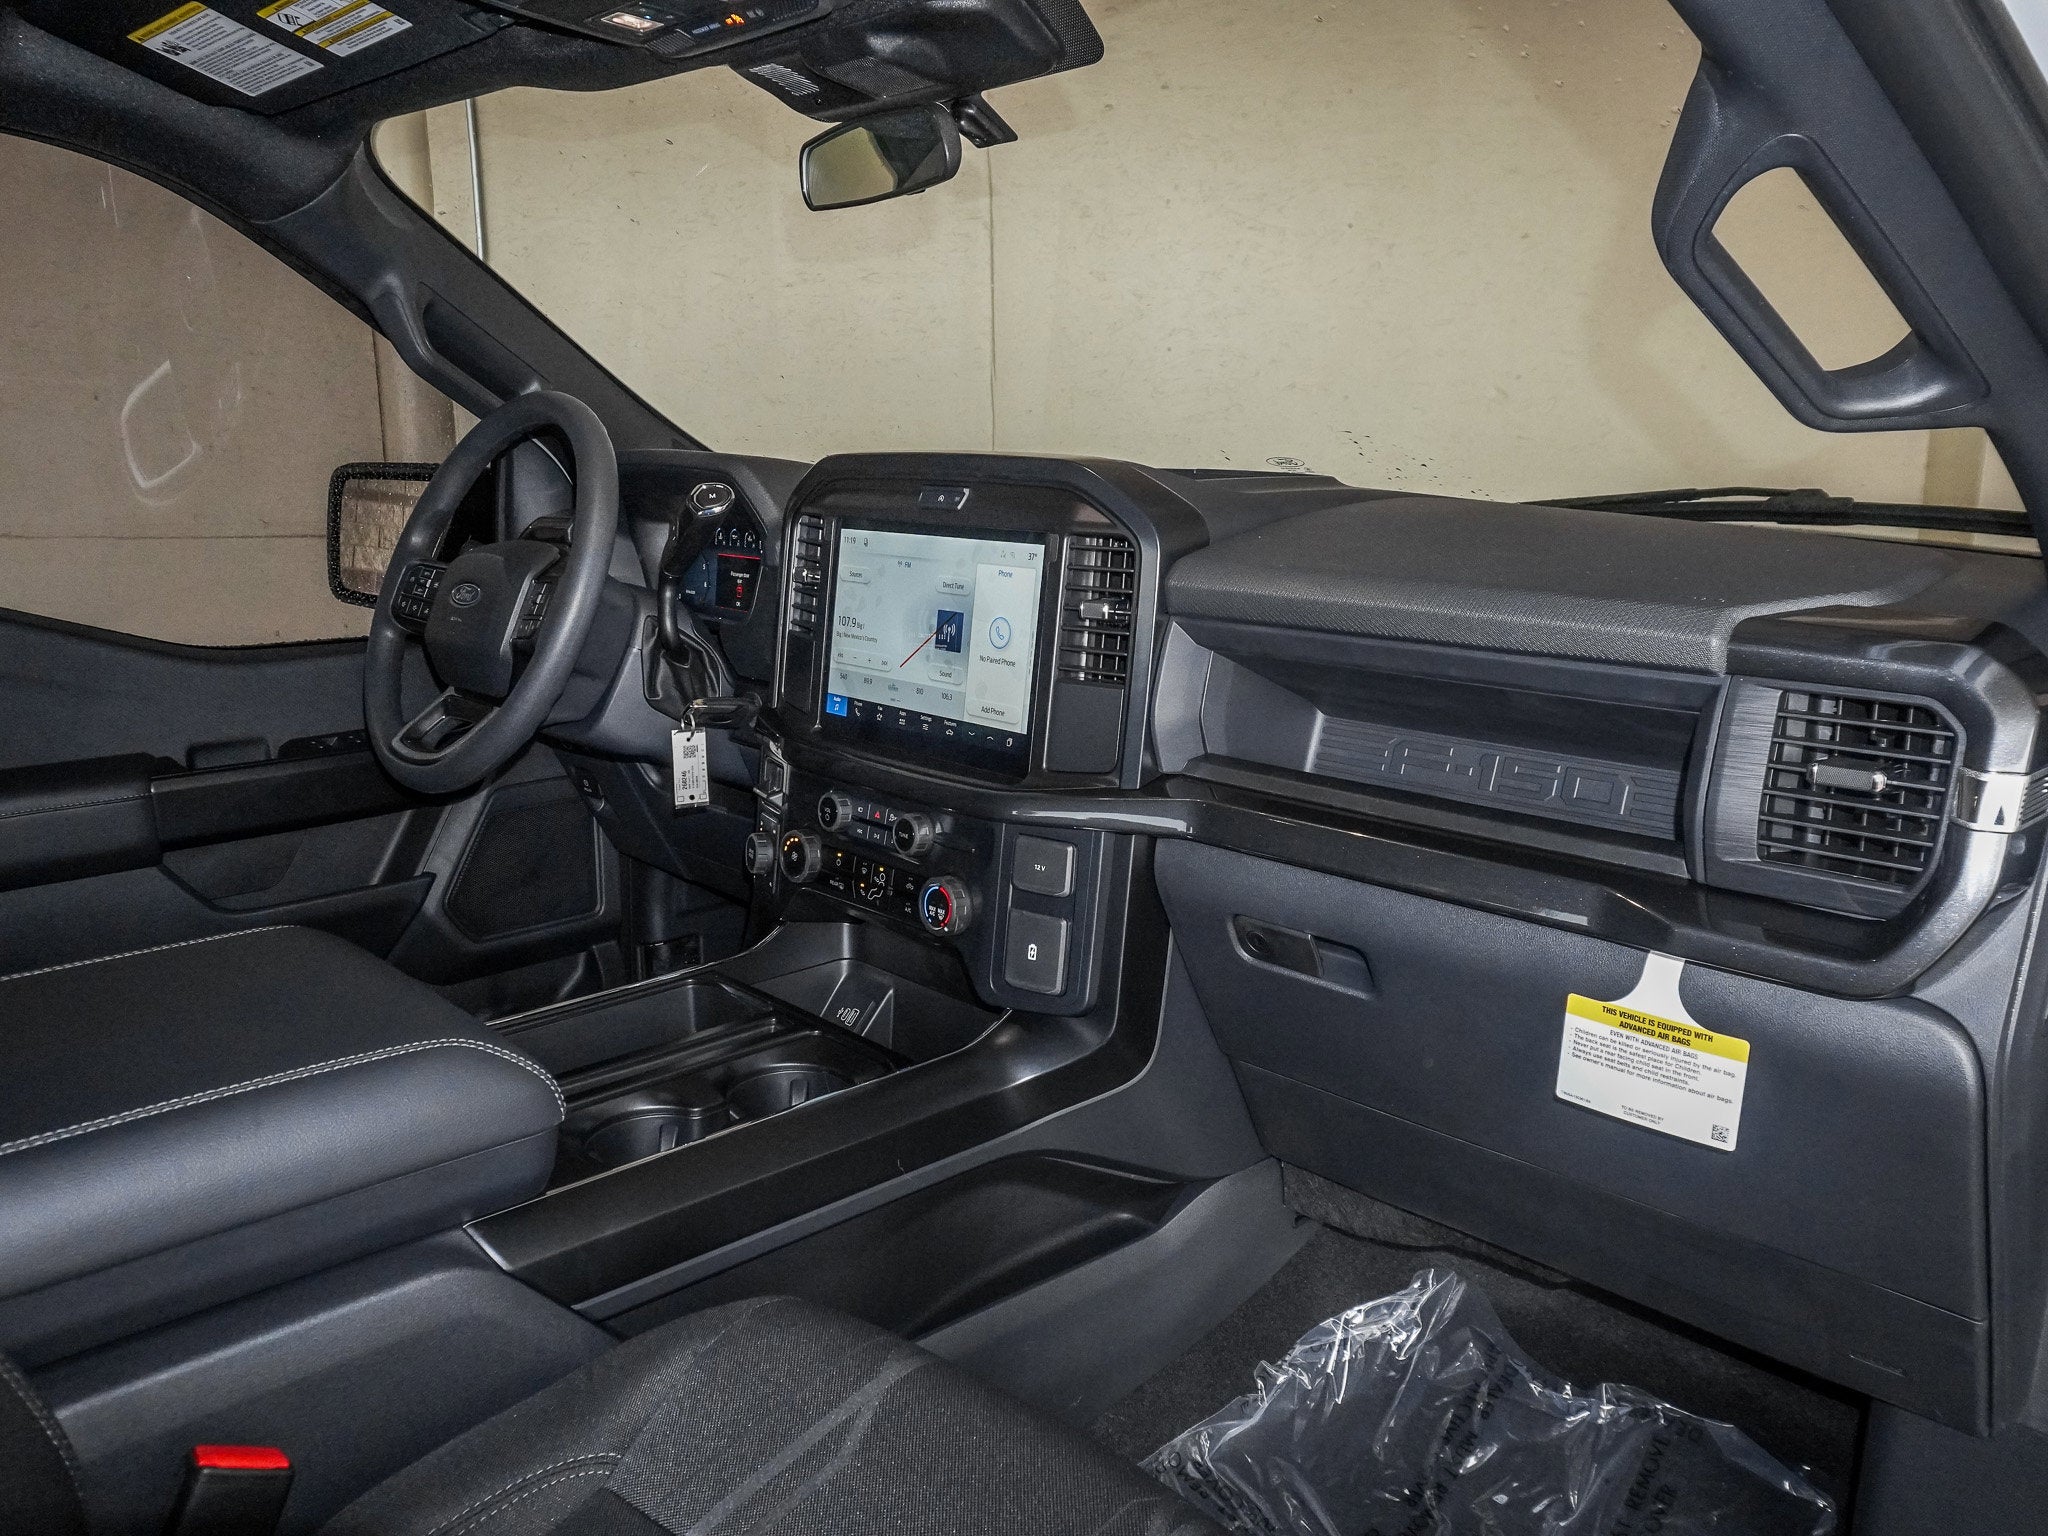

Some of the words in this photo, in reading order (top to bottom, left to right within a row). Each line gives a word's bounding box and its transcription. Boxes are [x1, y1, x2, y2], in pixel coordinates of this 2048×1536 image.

[998, 570, 1013, 578] Phone
[942, 581, 954, 589] Direct
[954, 582, 964, 590] Tune
[454, 585, 477, 602] Ford
[838, 616, 856, 628] 107.9
[986, 656, 1001, 664] Paired
[1001, 658, 1016, 668] Phone
[939, 670, 952, 678] Sound
[981, 706, 990, 714] Add
[990, 707, 1005, 716] Phone
[1602, 1006, 1616, 1015] THIS
[1618, 1011, 1646, 1024] VEHICLE
[1657, 1022, 1691, 1036] EQUIPPED
[1693, 1031, 1712, 1042] WITH
[1619, 1021, 1655, 1036] ADVANCED
[1657, 1032, 1669, 1040] AIR
[1671, 1036, 1690, 1046] BAGS
[1572, 1046, 1591, 1056] Always
[1574, 1028, 1597, 1037] Children
[1642, 1048, 1668, 1058] seriously
[1670, 1056, 1691, 1065] injured
[1640, 1039, 1669, 1051] ADVANCED
[1616, 1053, 1634, 1063] facing
[1647, 1056, 1663, 1065] place
[1604, 1063, 1625, 1072] manual
[1652, 1077, 1686, 1090] information
[1687, 1087, 1705, 1096] about
